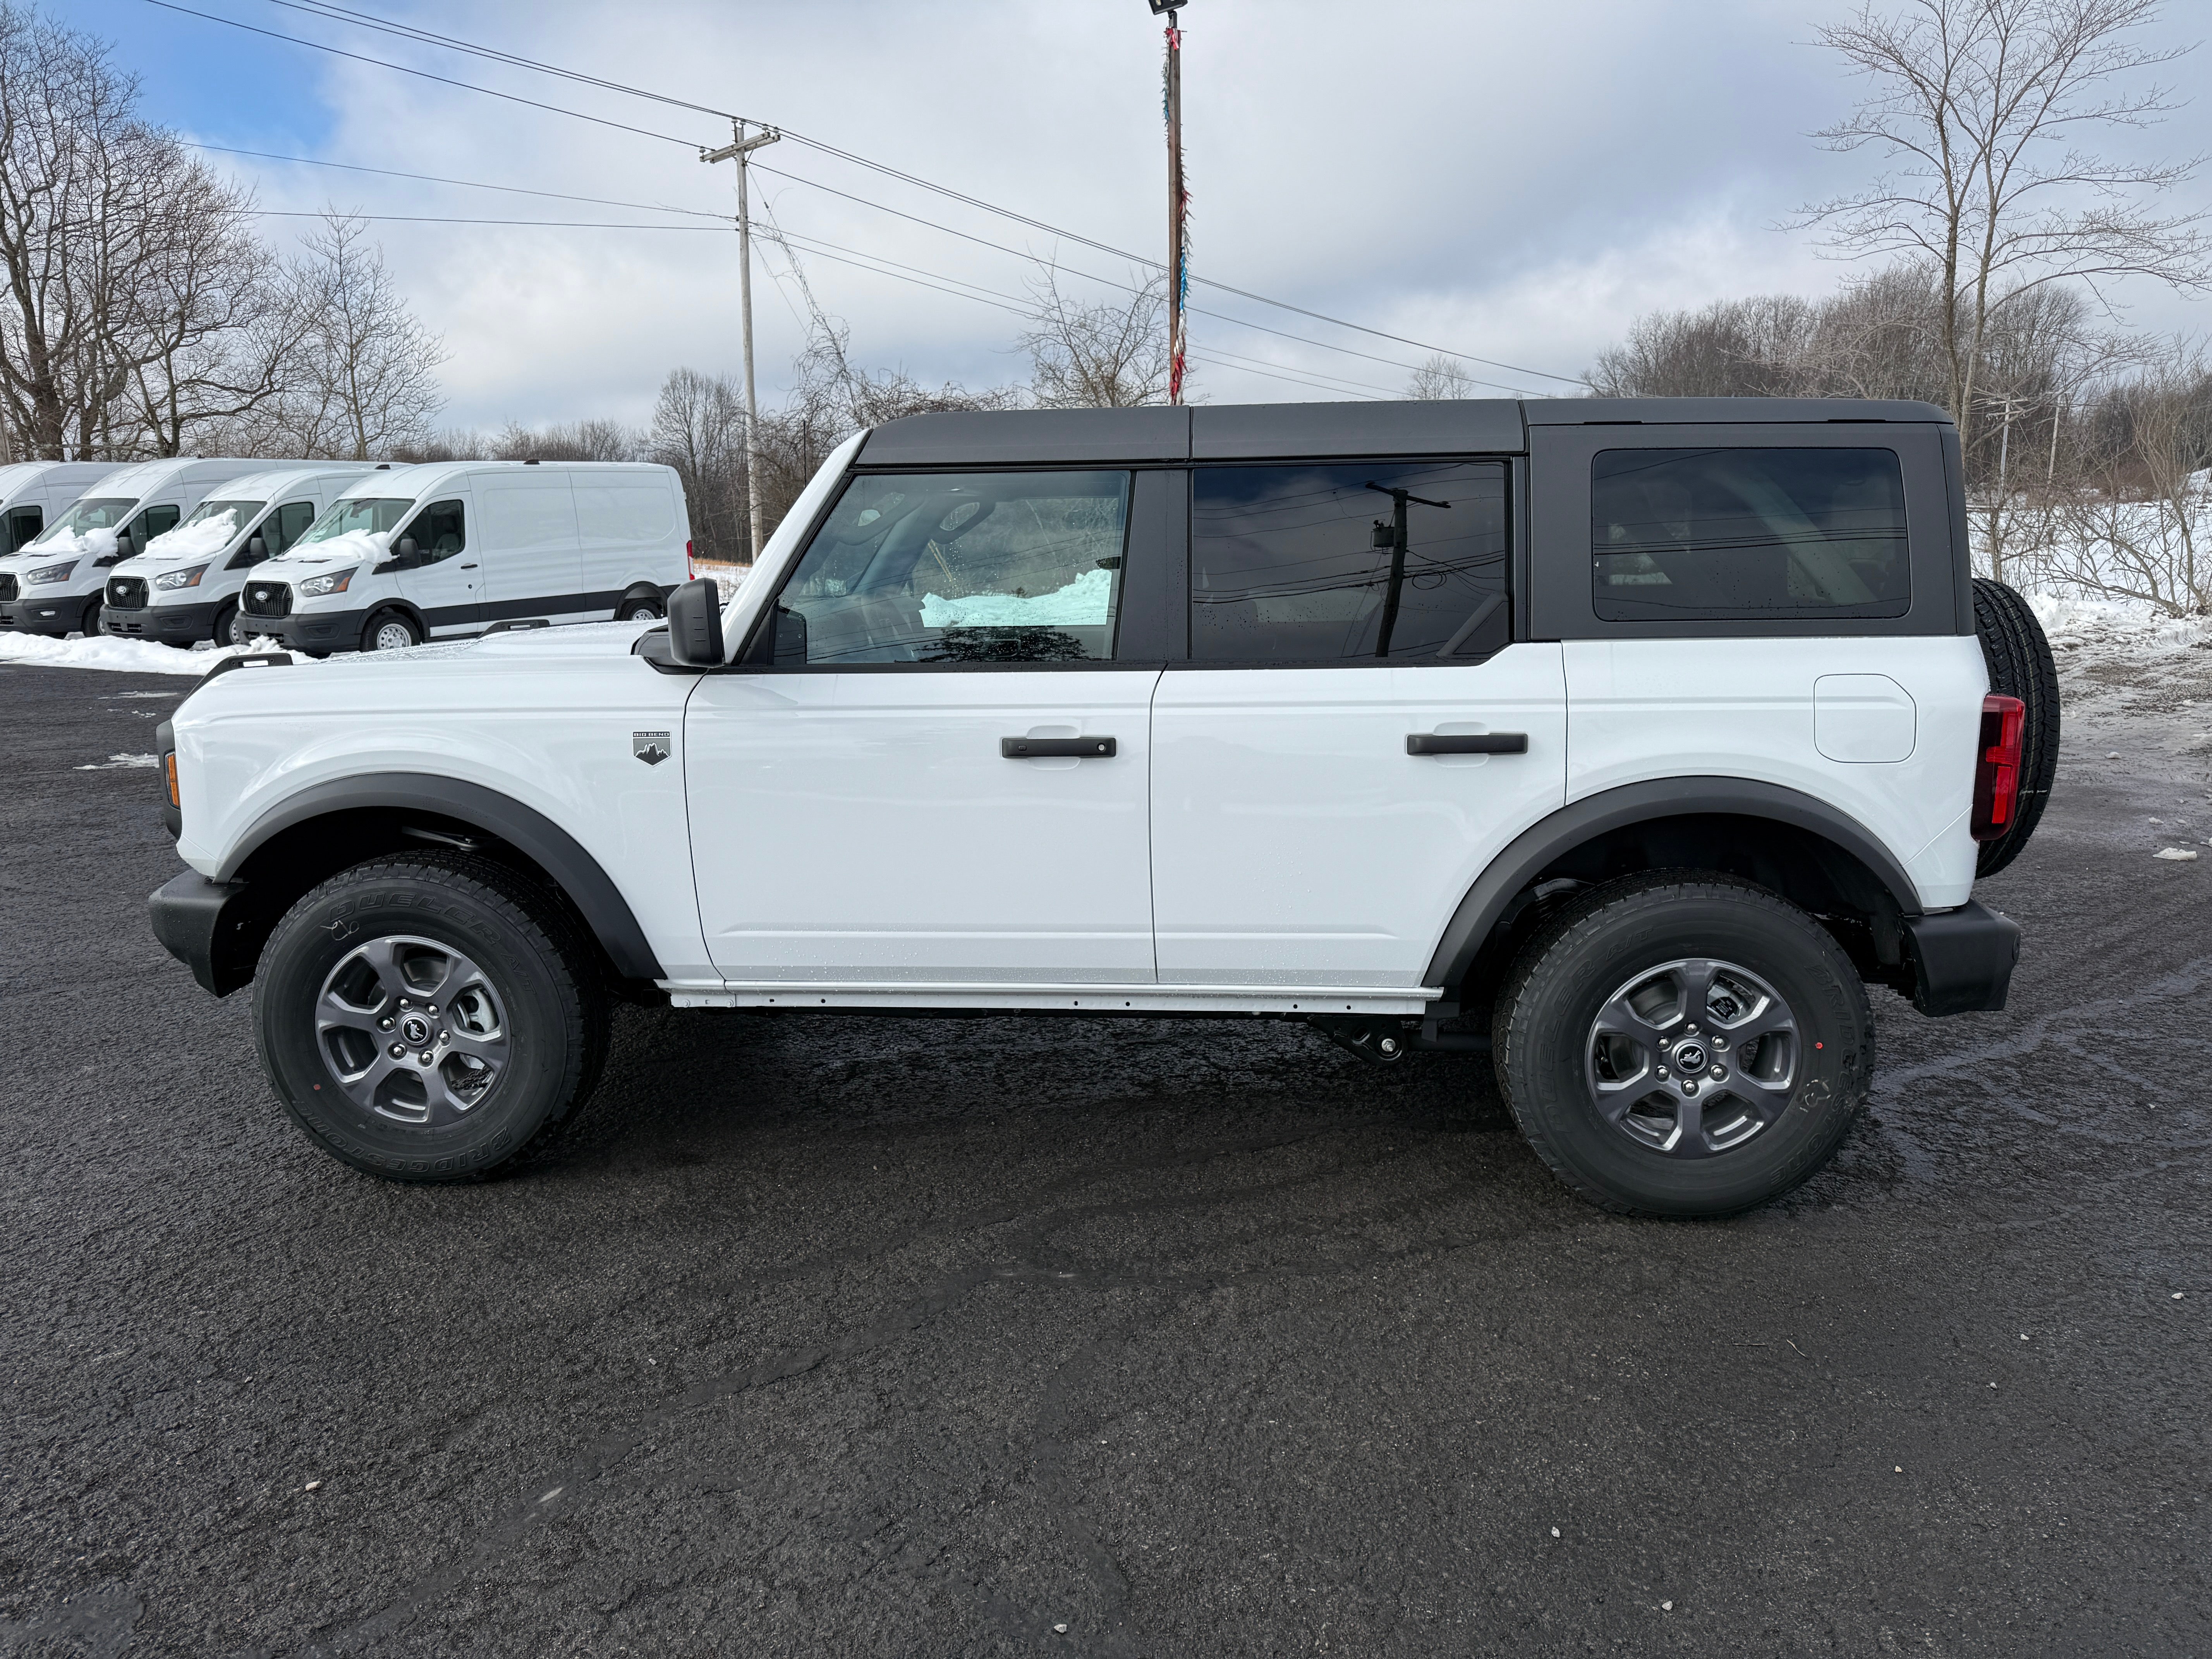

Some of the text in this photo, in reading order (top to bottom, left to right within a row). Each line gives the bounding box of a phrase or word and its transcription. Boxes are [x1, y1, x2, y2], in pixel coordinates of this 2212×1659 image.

[328, 891, 502, 946] DUELER
[500, 953, 537, 994] A/T
[1536, 927, 1654, 1134] DUELER A/T
[292, 1099, 512, 1173] BRIDGESTONE
